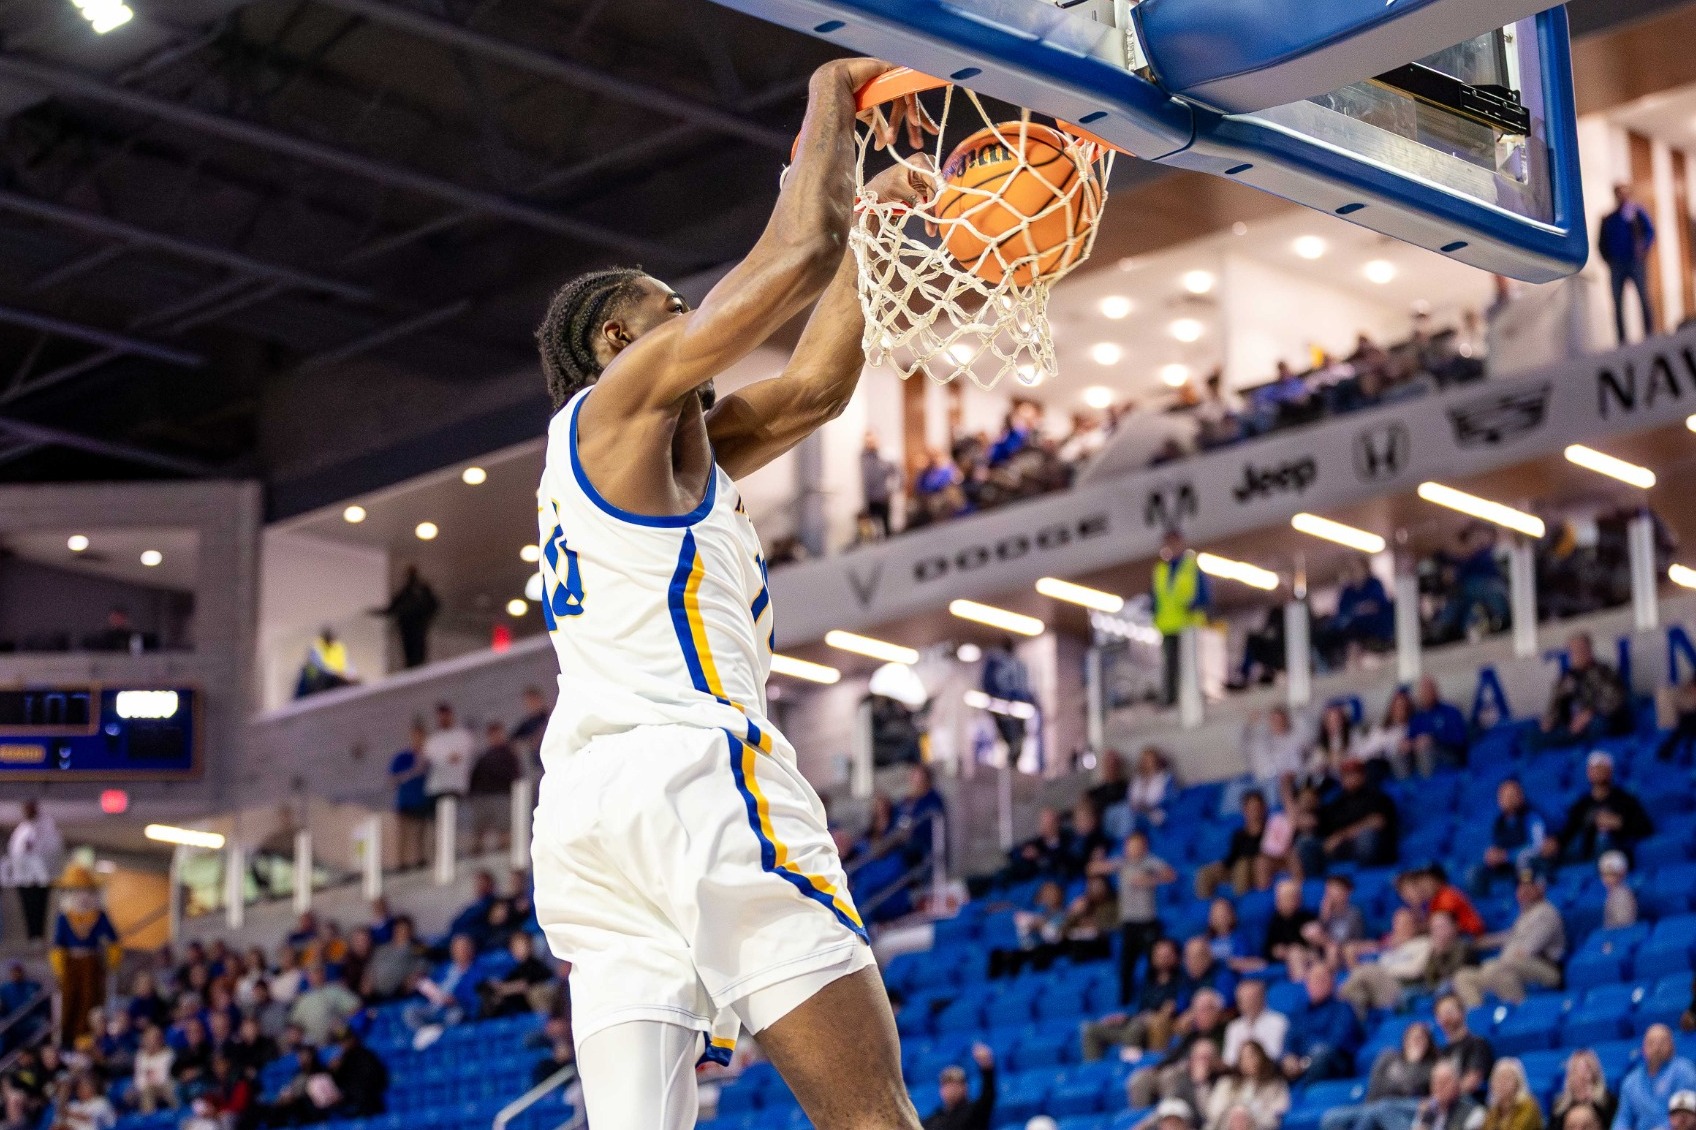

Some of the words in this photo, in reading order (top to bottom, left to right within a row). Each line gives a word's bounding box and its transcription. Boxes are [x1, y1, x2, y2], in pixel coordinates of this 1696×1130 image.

[943, 141, 1012, 178] Wil
[1232, 456, 1318, 505] Jeep
[911, 513, 1111, 584] DODGE
